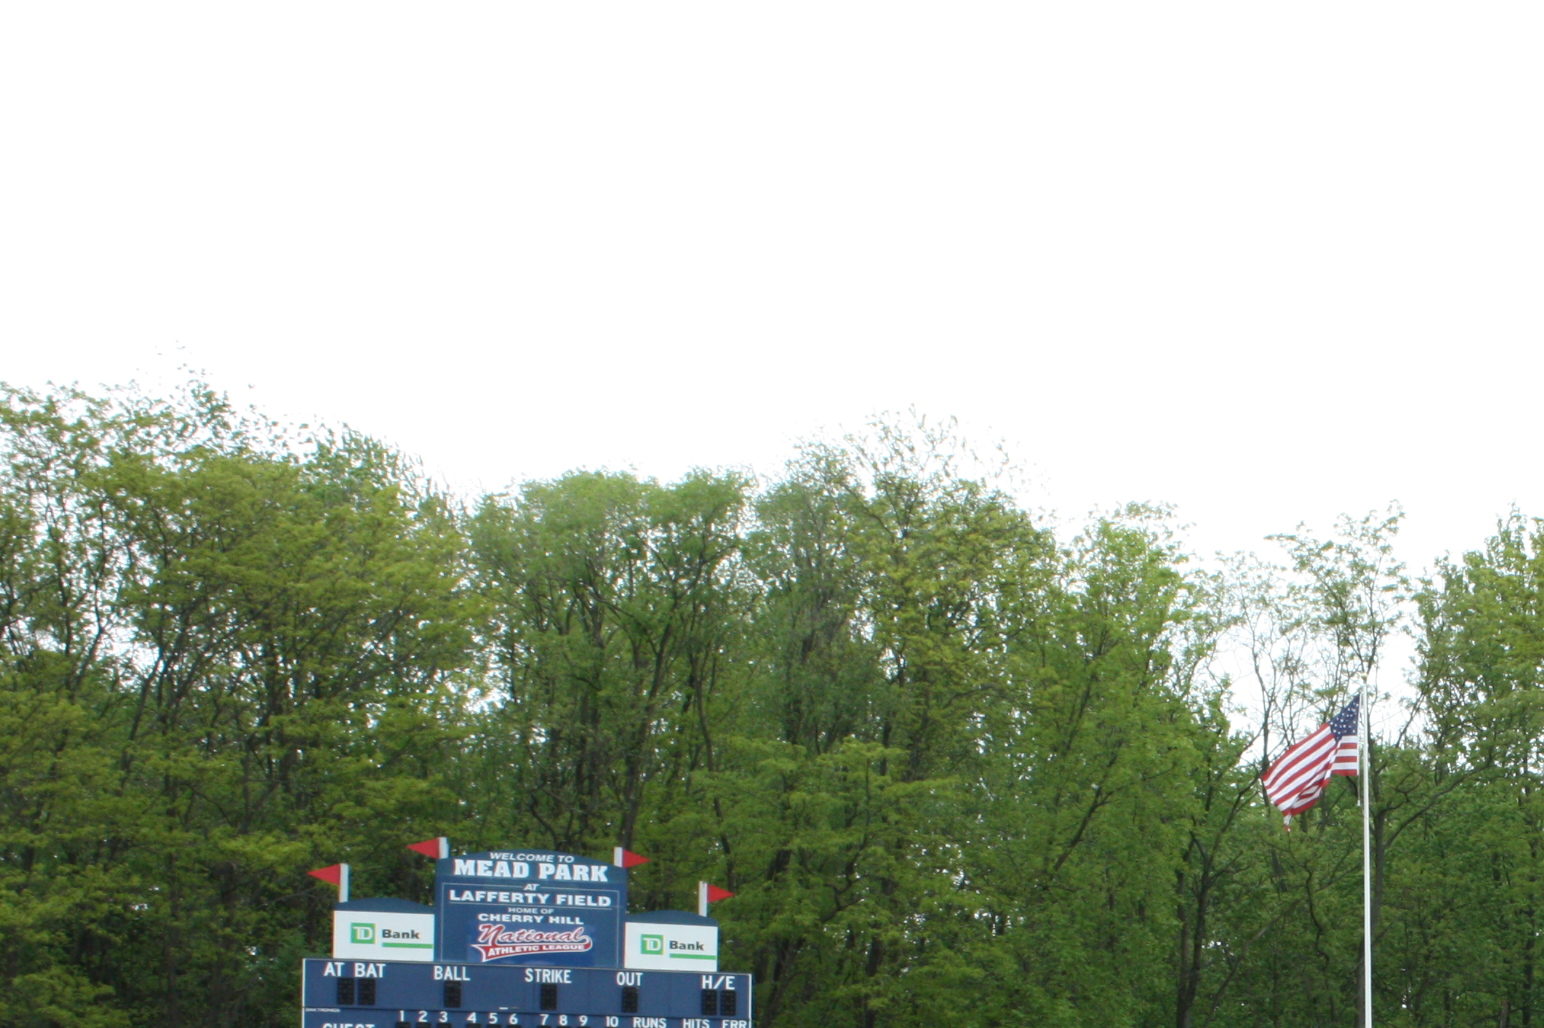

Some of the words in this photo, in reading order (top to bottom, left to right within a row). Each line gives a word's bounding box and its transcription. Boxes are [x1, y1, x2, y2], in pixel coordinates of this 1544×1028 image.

[490, 852, 554, 863] WELCOME
[557, 855, 574, 863] TO
[454, 859, 530, 878] MEAD
[538, 863, 608, 882] PARK
[523, 883, 539, 891] AT
[449, 890, 550, 904] LAFFERTY
[556, 894, 612, 907] FIELD
[477, 913, 544, 923] CHERRY
[548, 916, 584, 925] HILL
[382, 929, 420, 939] Bank
[478, 923, 586, 946] National
[488, 944, 540, 956] ATHLETIC
[669, 941, 704, 951] Bank
[324, 962, 345, 977] AT
[354, 963, 386, 978] BAT
[433, 965, 470, 981] BALL
[524, 968, 572, 984] STRIKE
[616, 972, 643, 986] OUT
[702, 975, 735, 990] H/E
[399, 1010, 405, 1022] 1
[419, 1010, 428, 1022] 2
[439, 1011, 448, 1023] 3
[467, 1012, 476, 1023] 4
[489, 1012, 498, 1024] 5
[509, 1013, 518, 1025] 6
[540, 1014, 549, 1026] 7
[559, 1015, 568, 1026] 8
[579, 1015, 588, 1026] 9
[605, 1016, 619, 1027] 10
[633, 1017, 667, 1028] RUNS
